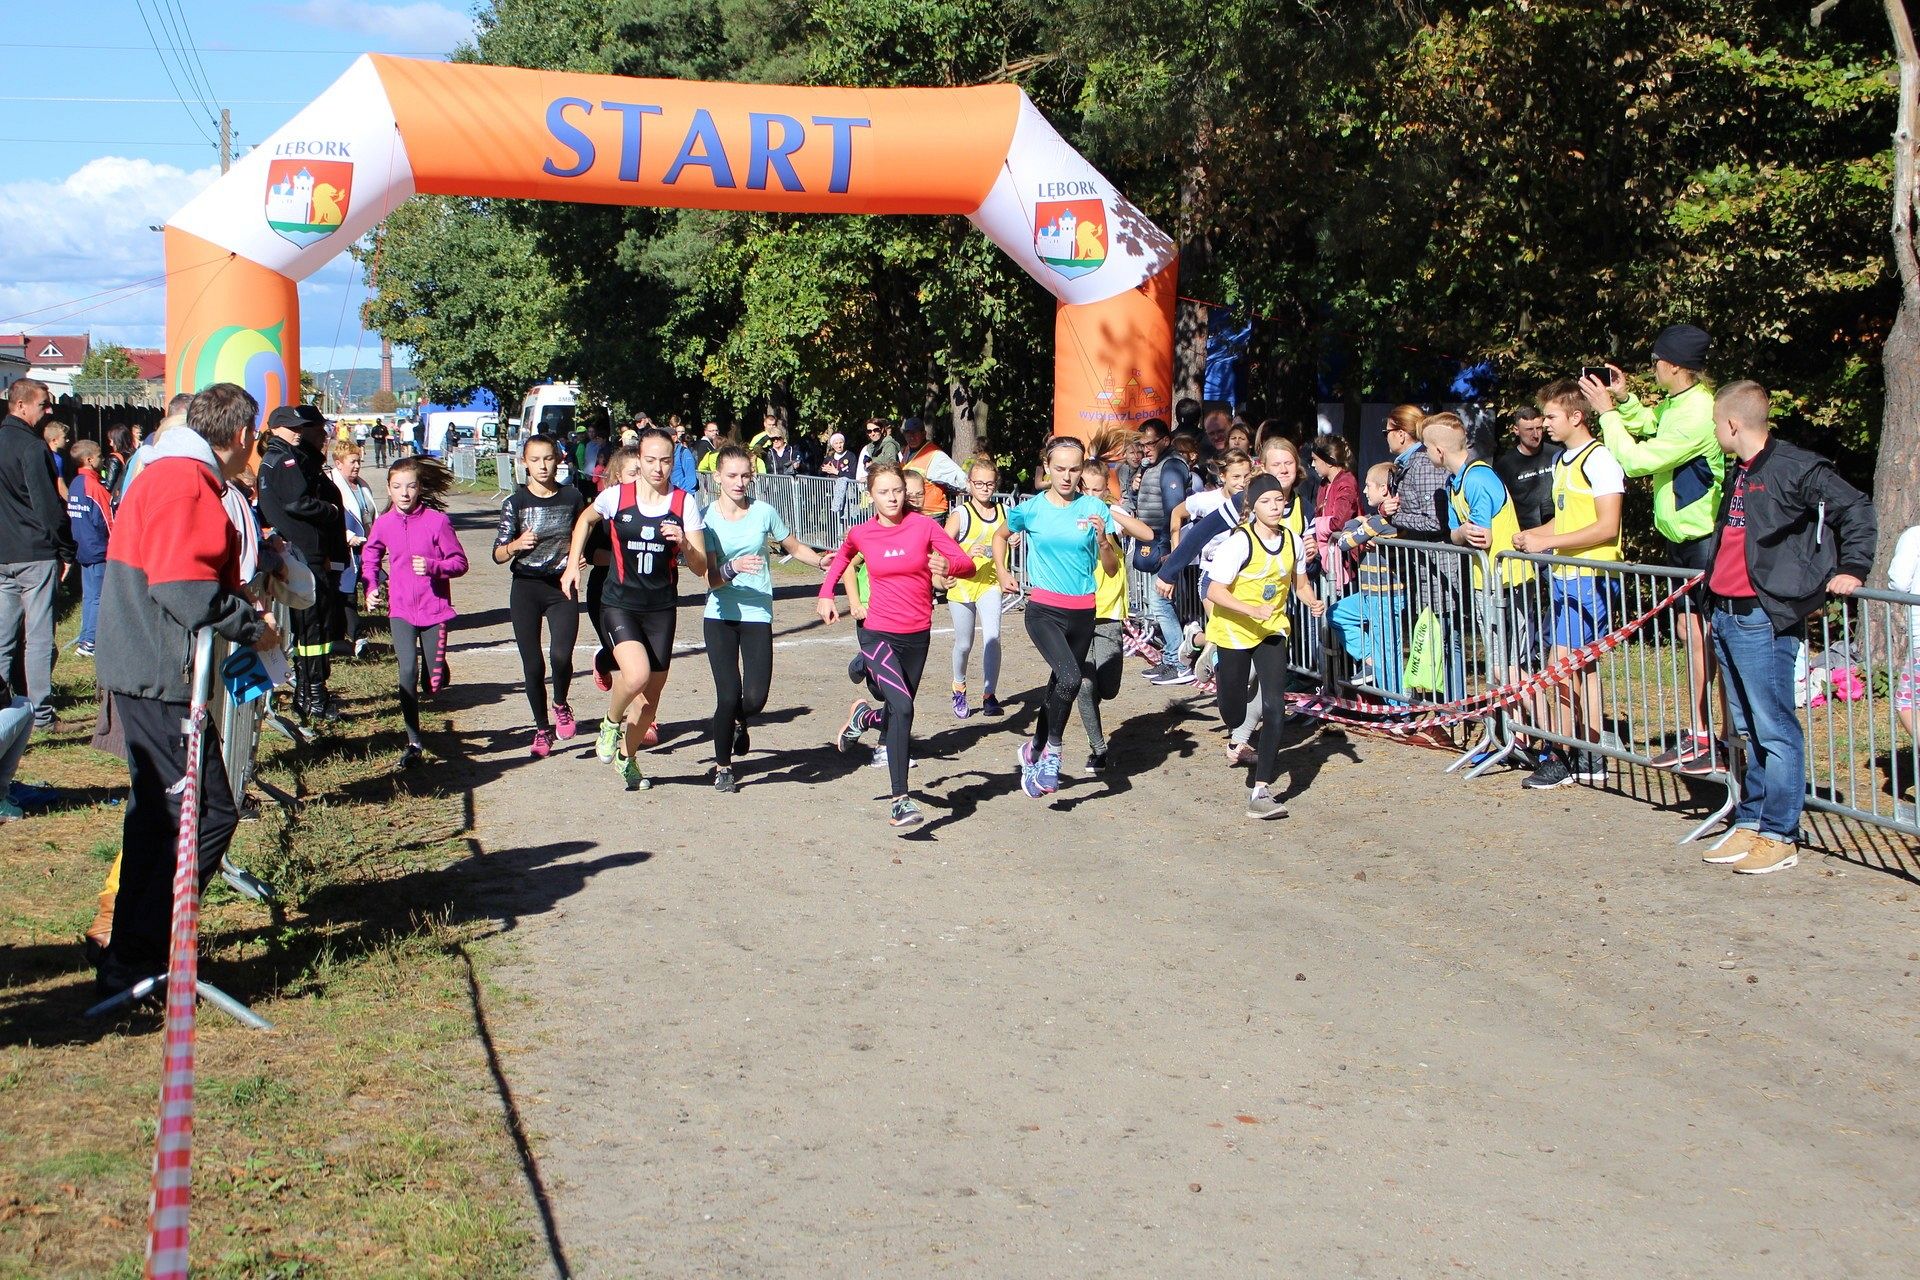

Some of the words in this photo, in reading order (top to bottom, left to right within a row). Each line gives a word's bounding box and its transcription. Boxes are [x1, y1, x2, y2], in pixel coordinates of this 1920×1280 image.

[276, 140, 352, 157] LĘBORK
[542, 96, 872, 194] START
[1038, 181, 1098, 200] LĘBORK
[636, 552, 653, 574] 10
[1414, 623, 1428, 655] RACING
[1411, 654, 1420, 677] NIKE
